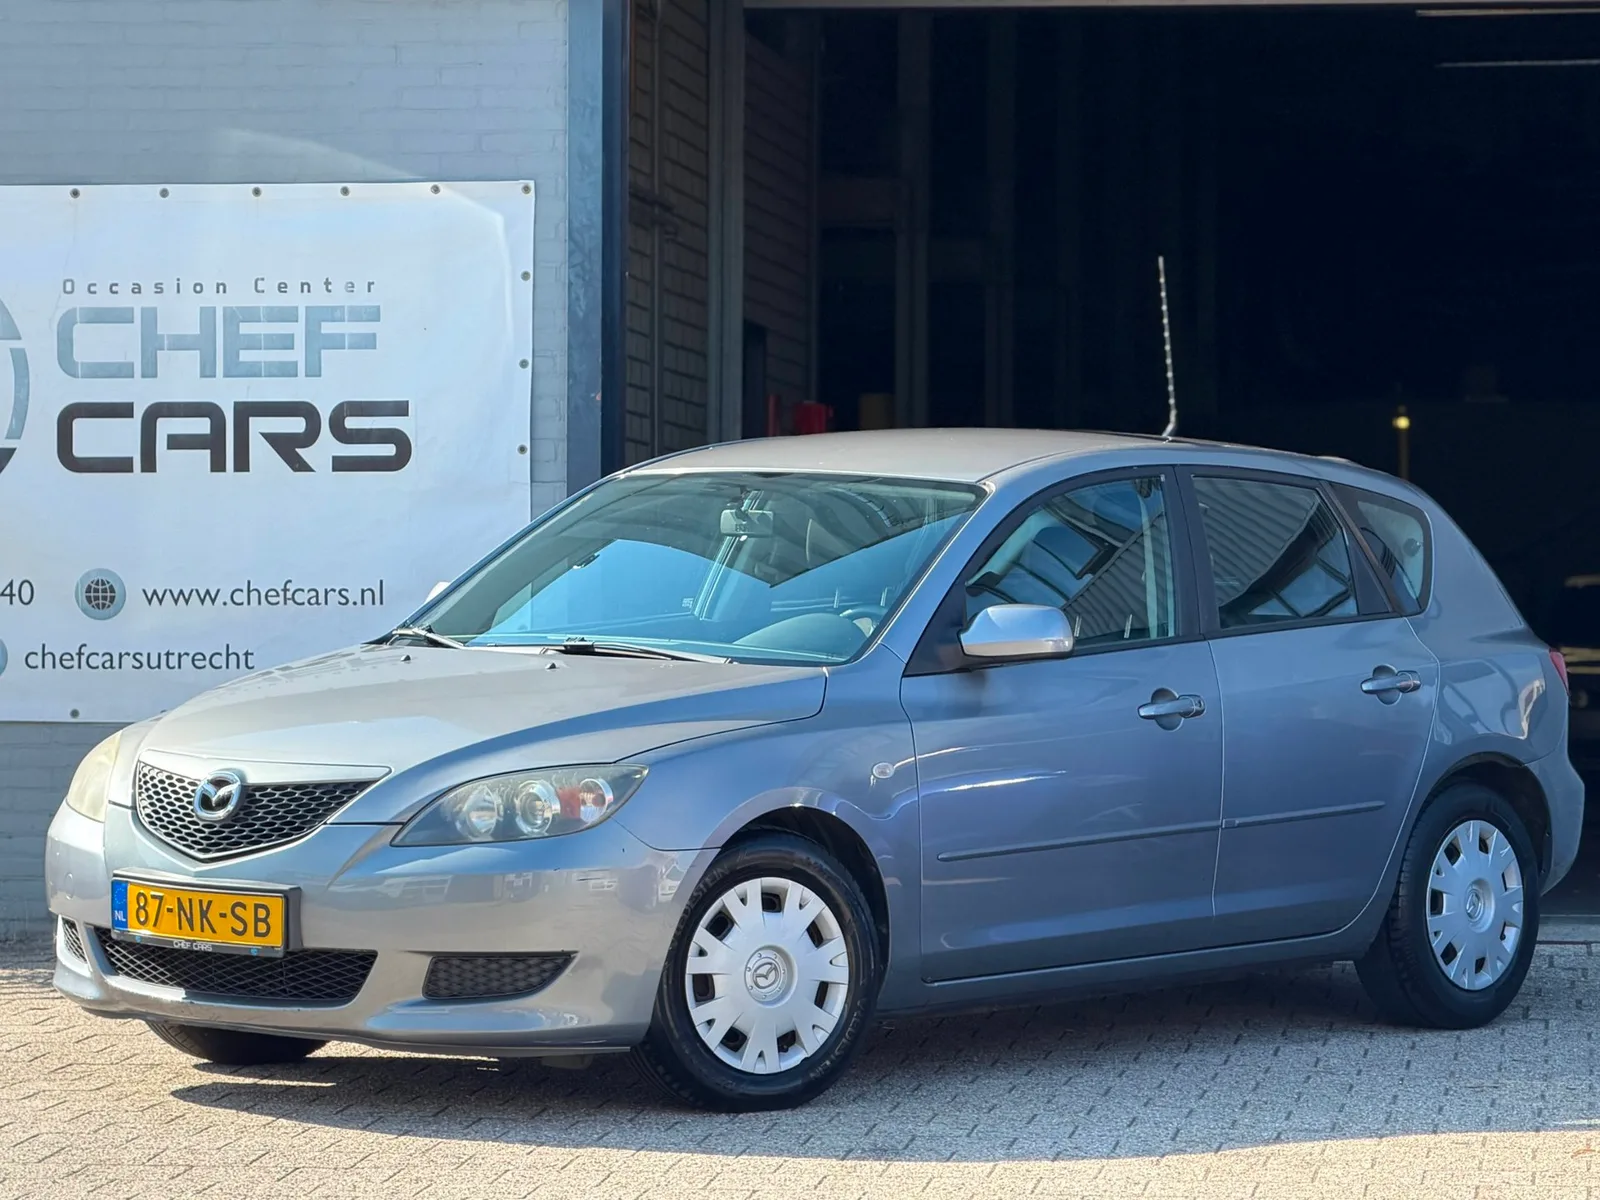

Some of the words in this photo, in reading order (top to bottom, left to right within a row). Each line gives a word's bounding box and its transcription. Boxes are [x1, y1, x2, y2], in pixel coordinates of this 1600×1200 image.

[62, 278, 228, 295] Occasion
[253, 277, 376, 294] Center
[56, 304, 381, 379] CHEF
[56, 399, 413, 474] CARS
[141, 580, 385, 607] www.chefcars.nl
[24, 643, 256, 671] chefcarsutrecht
[114, 910, 126, 922] NL
[135, 891, 272, 938] 87-NK-SB
